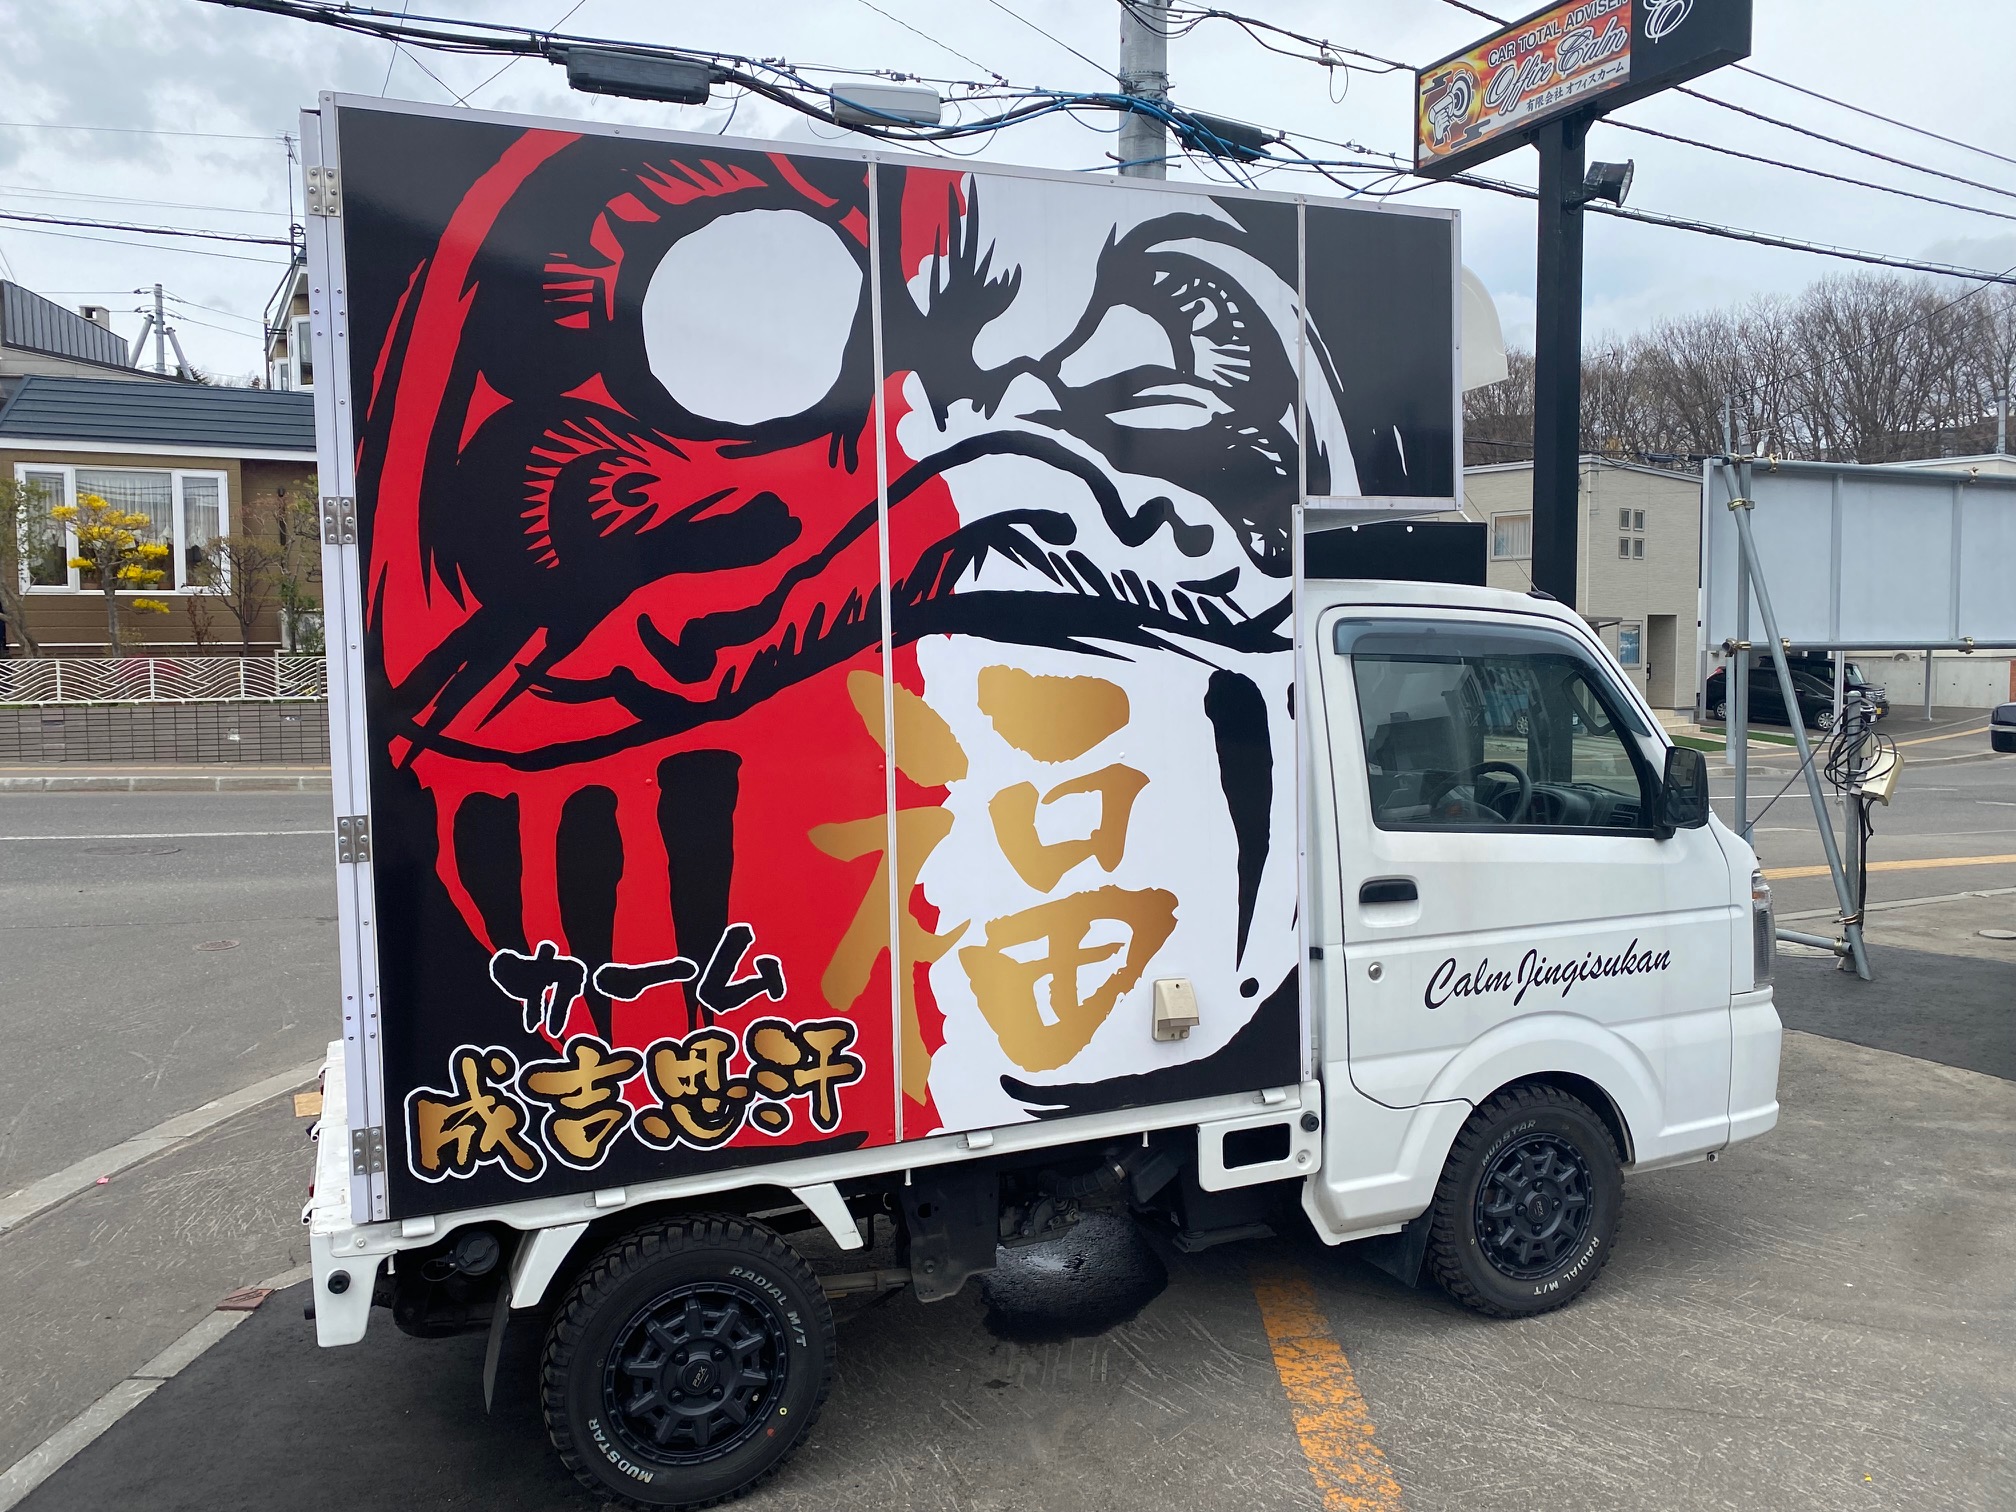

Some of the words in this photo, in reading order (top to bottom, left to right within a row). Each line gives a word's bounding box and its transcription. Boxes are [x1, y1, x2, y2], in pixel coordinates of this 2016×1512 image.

[1484, 53, 1553, 115] Office
[1557, 16, 1628, 77] Calm
[1489, 43, 1515, 66] CAR
[1519, 22, 1561, 51] TOTAL
[1526, 86, 1563, 112] 有限会社
[1566, 61, 1624, 94] オフィスカーム
[807, 664, 1179, 1106] 福
[489, 923, 786, 1038] カーム
[1424, 957, 1513, 1009] Calm
[1513, 939, 1671, 1006] Jingisukan
[404, 1016, 866, 1182] 成吉思汗
[1481, 1119, 1536, 1167] MUDSTAR
[1533, 1280, 1560, 1296] M/T
[1563, 1236, 1600, 1282] RADIAL
[729, 1265, 788, 1306] RADIAL
[787, 1310, 807, 1348] M/T
[588, 1417, 655, 1484] MUDSTAR
